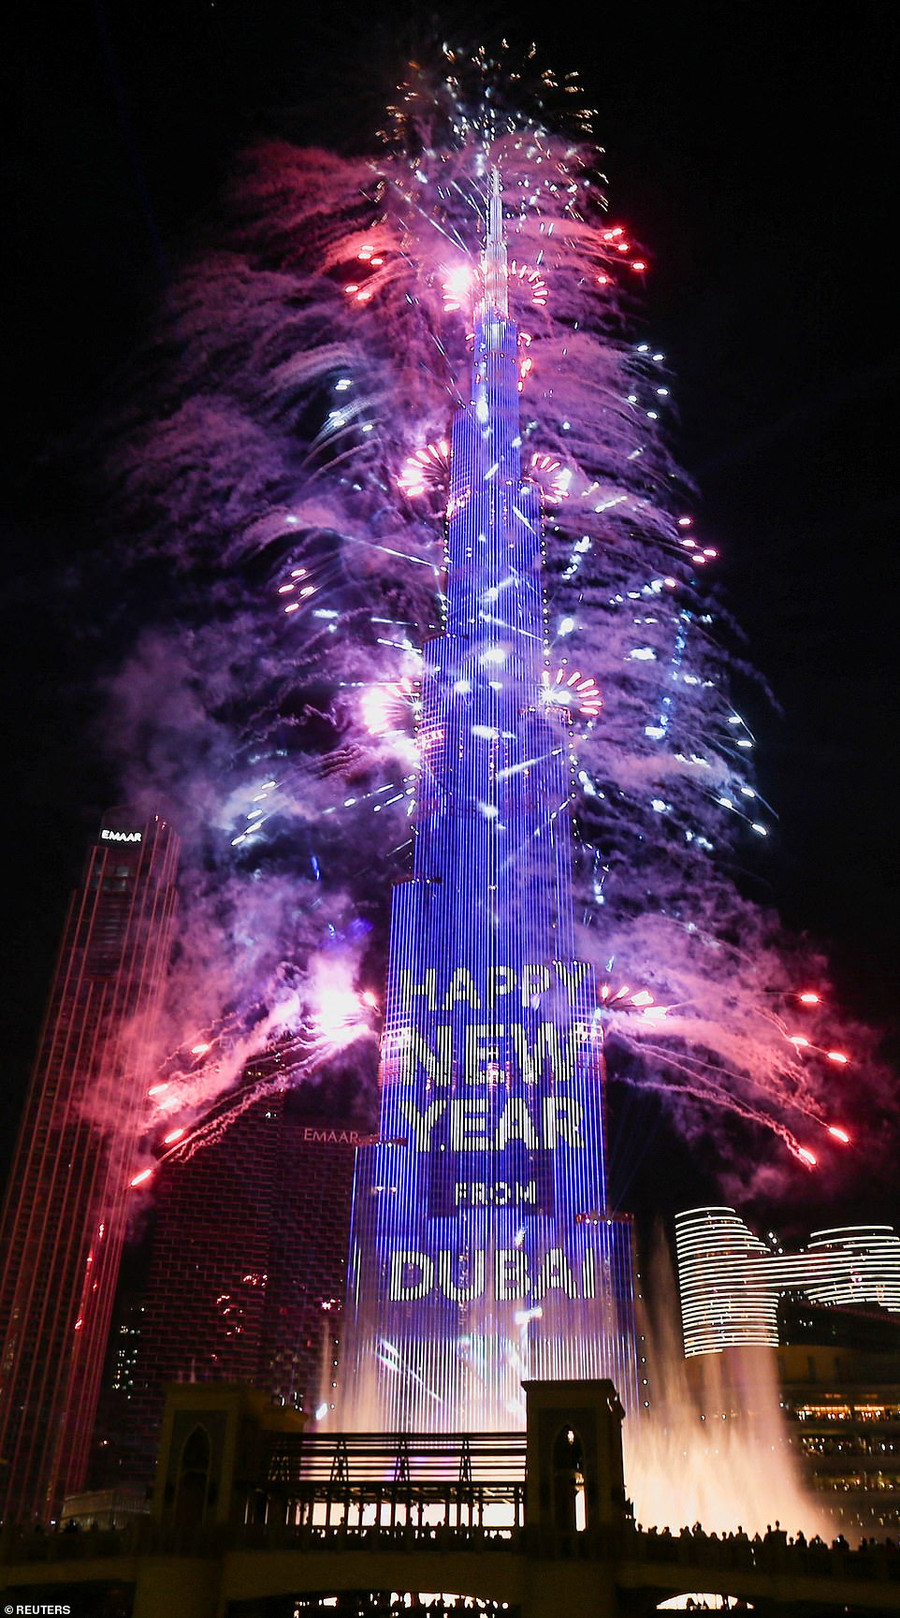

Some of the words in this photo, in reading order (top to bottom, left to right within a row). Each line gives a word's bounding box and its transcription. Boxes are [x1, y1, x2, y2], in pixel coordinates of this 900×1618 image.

[101, 829, 142, 842] EMAAR
[400, 962, 590, 1011] HAPPY
[400, 1022, 587, 1087] NEW
[304, 1127, 359, 1143] EMAAR
[399, 1097, 586, 1152] YEAR
[455, 1181, 537, 1206] FROM
[390, 1248, 595, 1302] DUBAI
